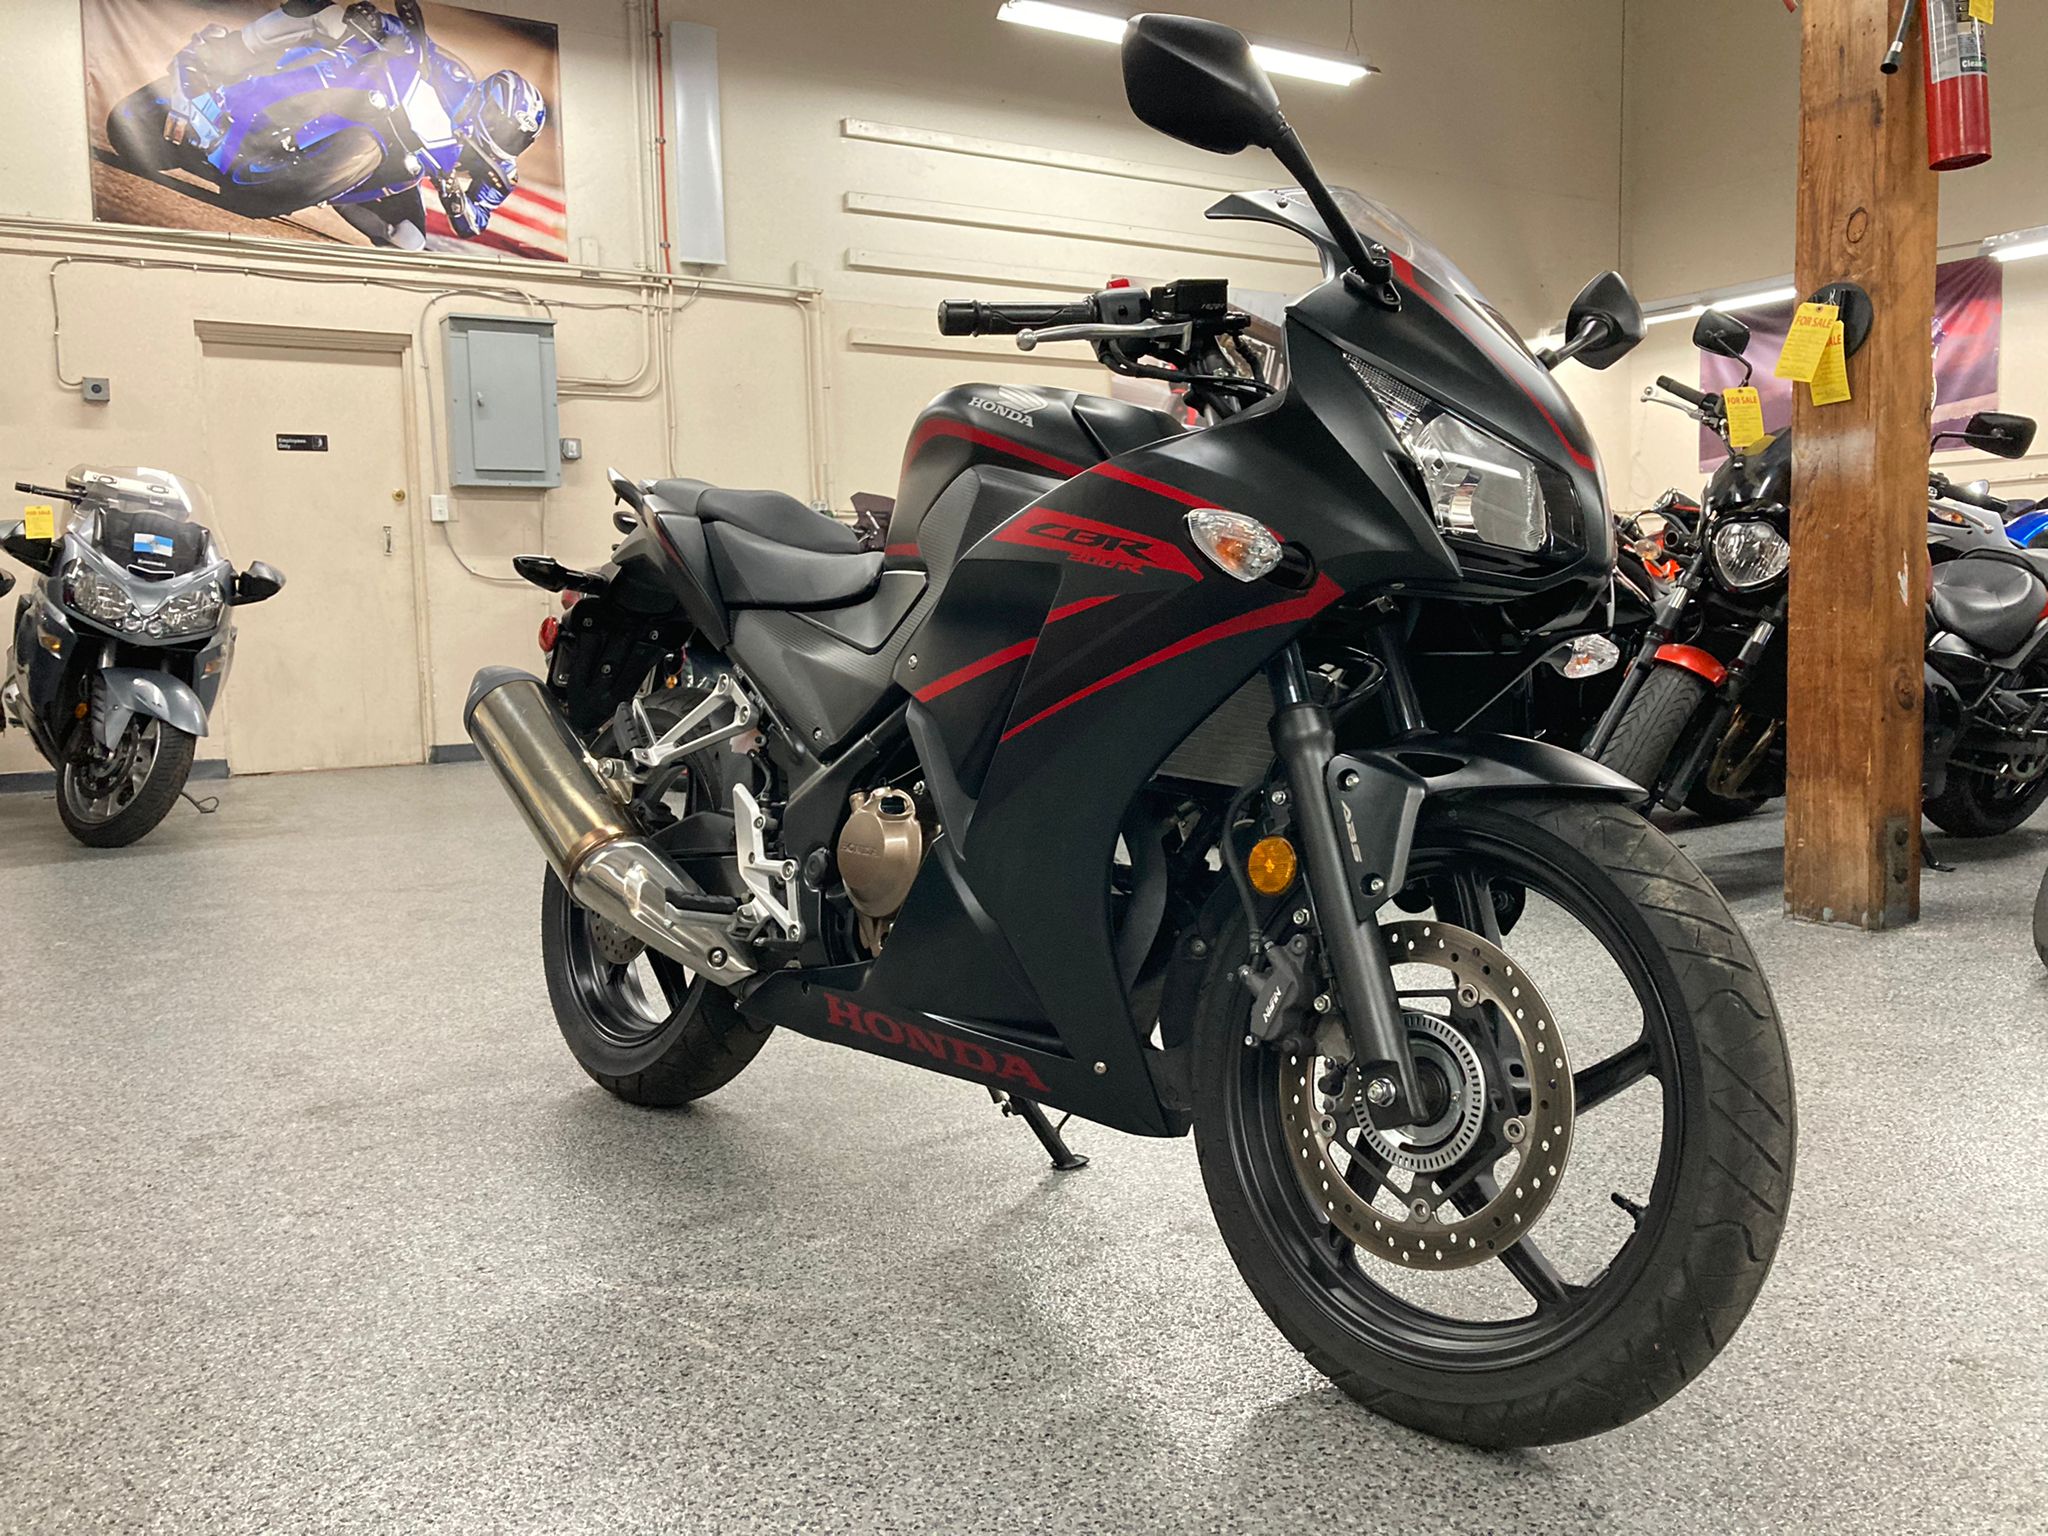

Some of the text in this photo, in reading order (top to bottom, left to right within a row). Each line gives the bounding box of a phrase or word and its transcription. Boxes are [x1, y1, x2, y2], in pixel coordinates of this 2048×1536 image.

[1795, 315, 1833, 329] FOR SALE
[968, 396, 1034, 428] HONDA
[1728, 395, 1758, 404] FOR SALE
[1025, 522, 1158, 563] CBR
[1066, 552, 1145, 575] 300R
[1341, 800, 1363, 863] ABS
[823, 992, 1052, 1092] HONDA
